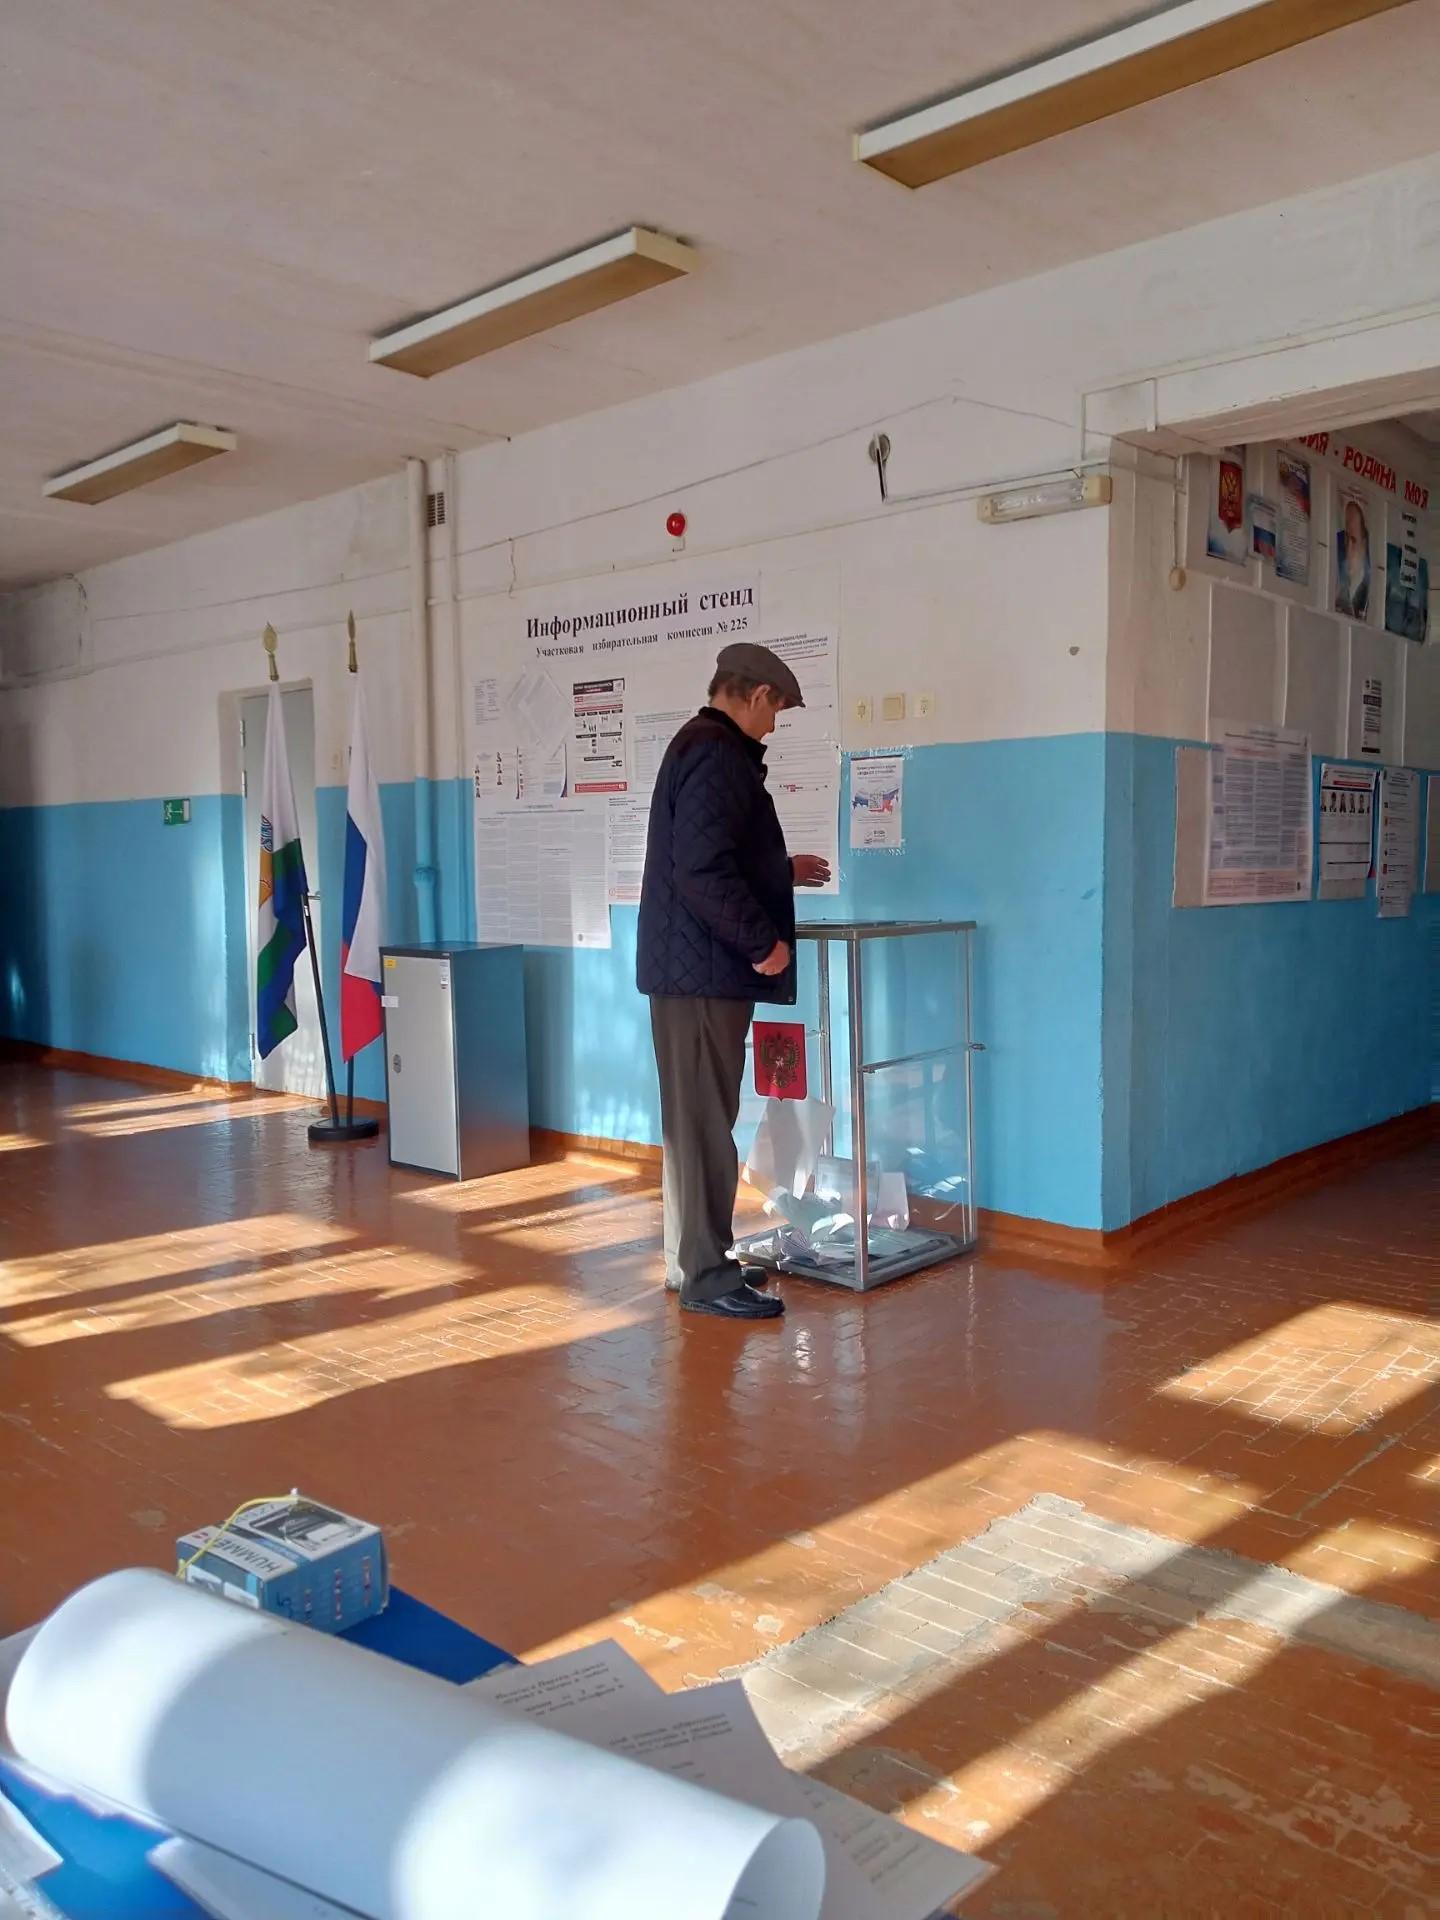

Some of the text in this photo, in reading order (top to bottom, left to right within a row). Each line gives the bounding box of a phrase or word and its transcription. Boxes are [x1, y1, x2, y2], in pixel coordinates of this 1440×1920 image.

[1343, 446, 1396, 493] РОДИНА
[1404, 480, 1429, 509] МОЯ
[526, 588, 753, 640] Информационный стенд
[535, 617, 748, 659] Участковая избирательная комиссия № 225
